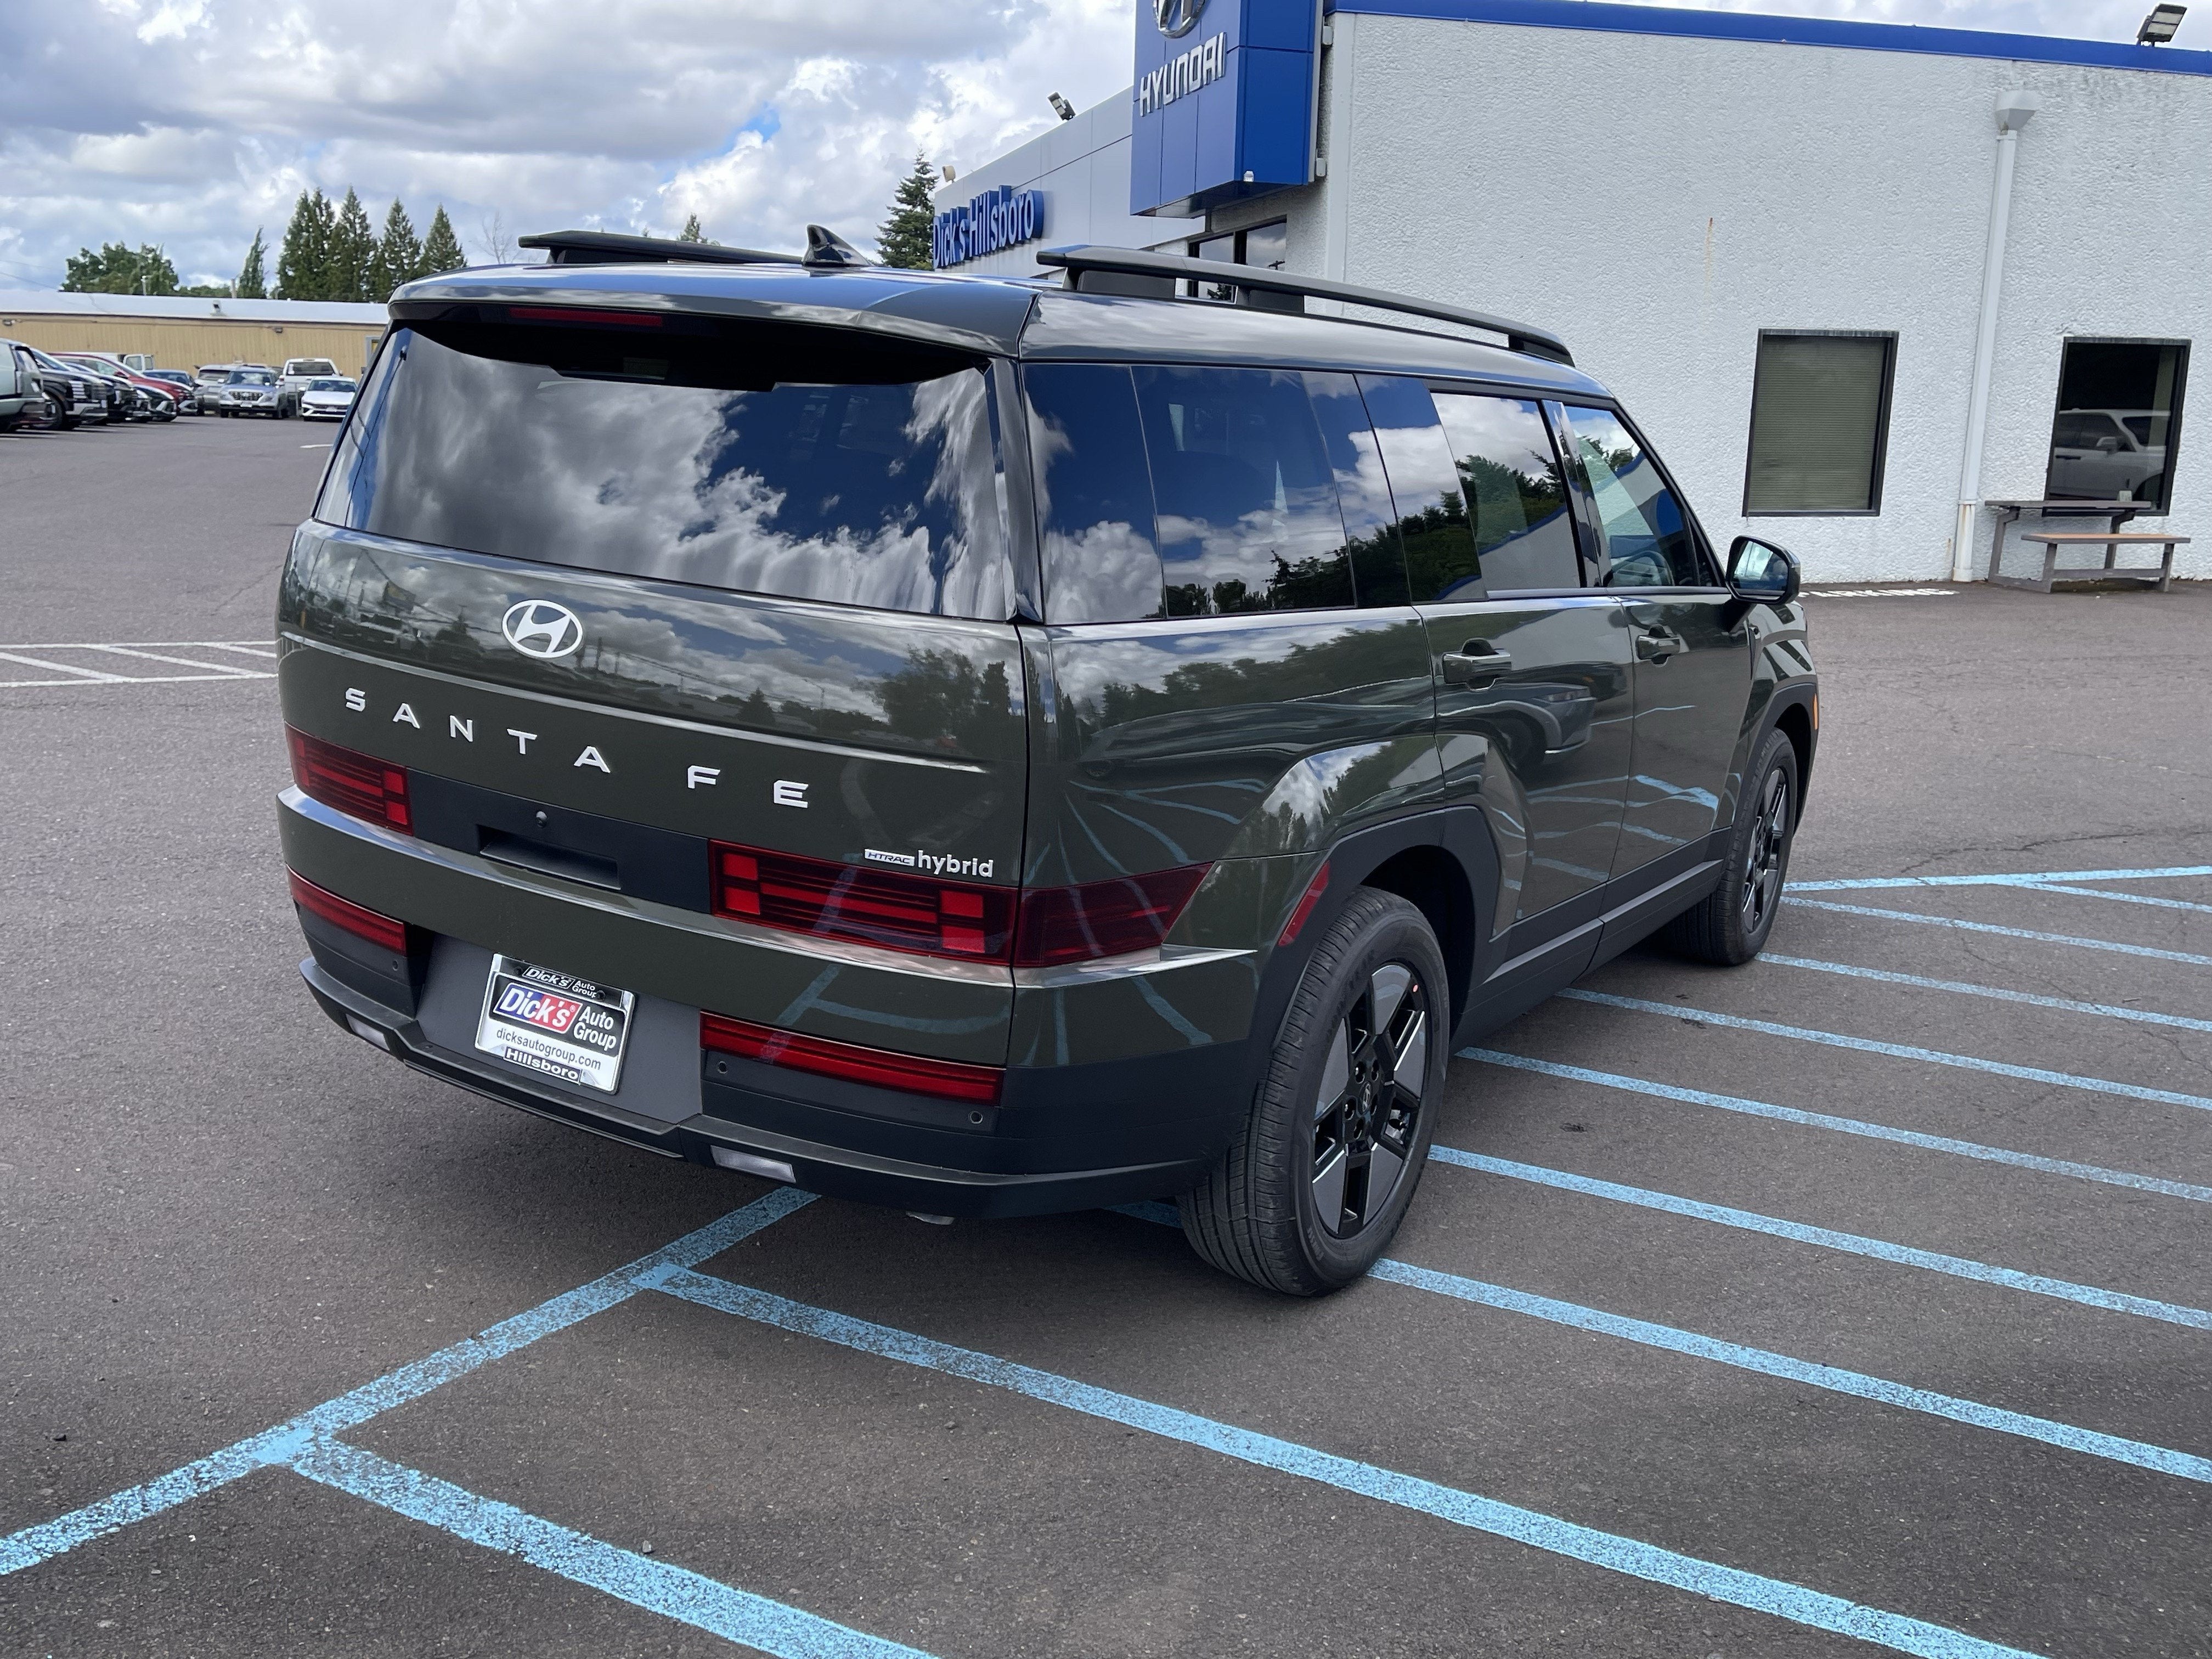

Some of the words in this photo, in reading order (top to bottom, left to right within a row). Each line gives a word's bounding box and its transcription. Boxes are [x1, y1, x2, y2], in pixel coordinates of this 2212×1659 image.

[1139, 32, 1227, 117] HYUNDAI
[933, 205, 967, 269] Dick's
[969, 185, 1036, 257] Hillsboro
[345, 687, 611, 774] SANTA
[687, 765, 809, 808] FE
[867, 852, 911, 864] HTRAC
[918, 850, 994, 877] hybrid
[525, 968, 572, 988] Dick's
[575, 980, 596, 991] Auto
[499, 988, 571, 1028] Dick's
[578, 1006, 614, 1030] Auto
[496, 1028, 601, 1070] dicksautogroup.com
[573, 1022, 617, 1051] Group
[506, 1048, 579, 1080] Hillsboro
